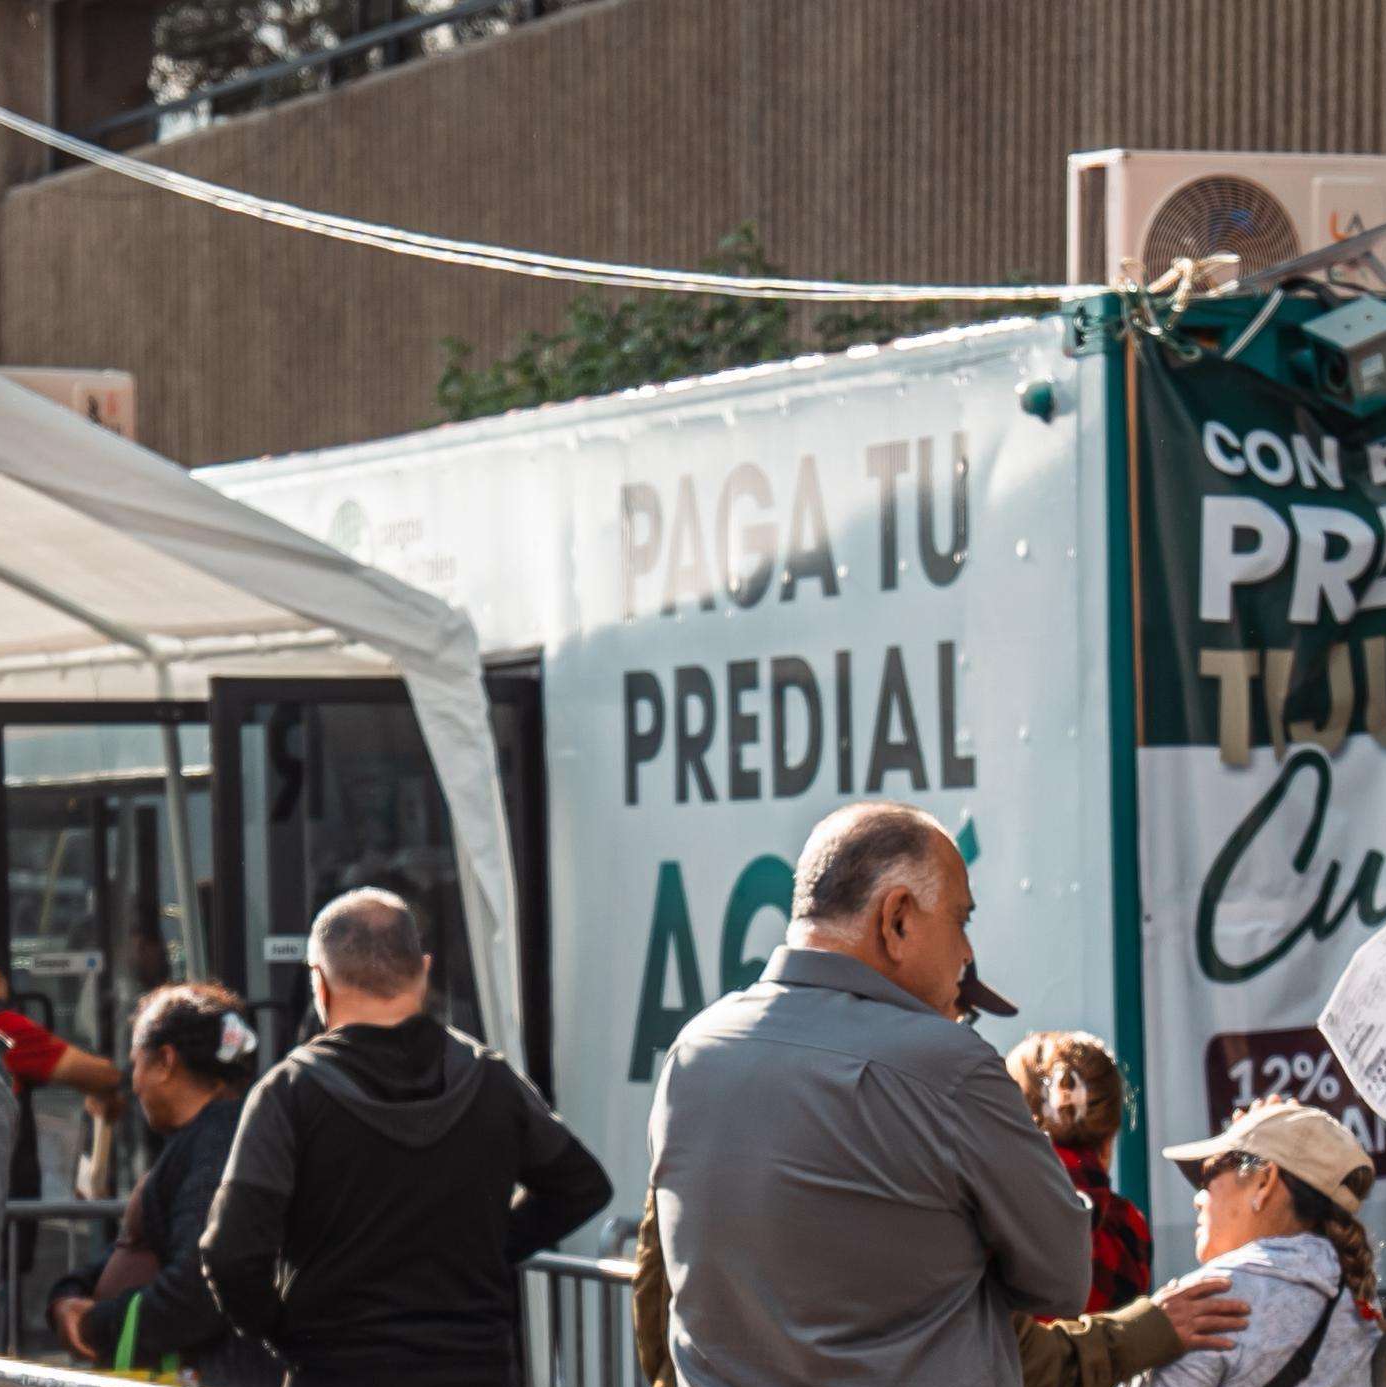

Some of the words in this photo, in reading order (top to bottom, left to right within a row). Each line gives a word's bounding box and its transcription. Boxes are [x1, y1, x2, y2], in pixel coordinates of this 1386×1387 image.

[1202, 420, 1345, 490] CON
[622, 453, 840, 620] PAGA
[866, 431, 970, 592] TU
[623, 640, 978, 807] PREDIAL
[1228, 1052, 1341, 1108] 12%
